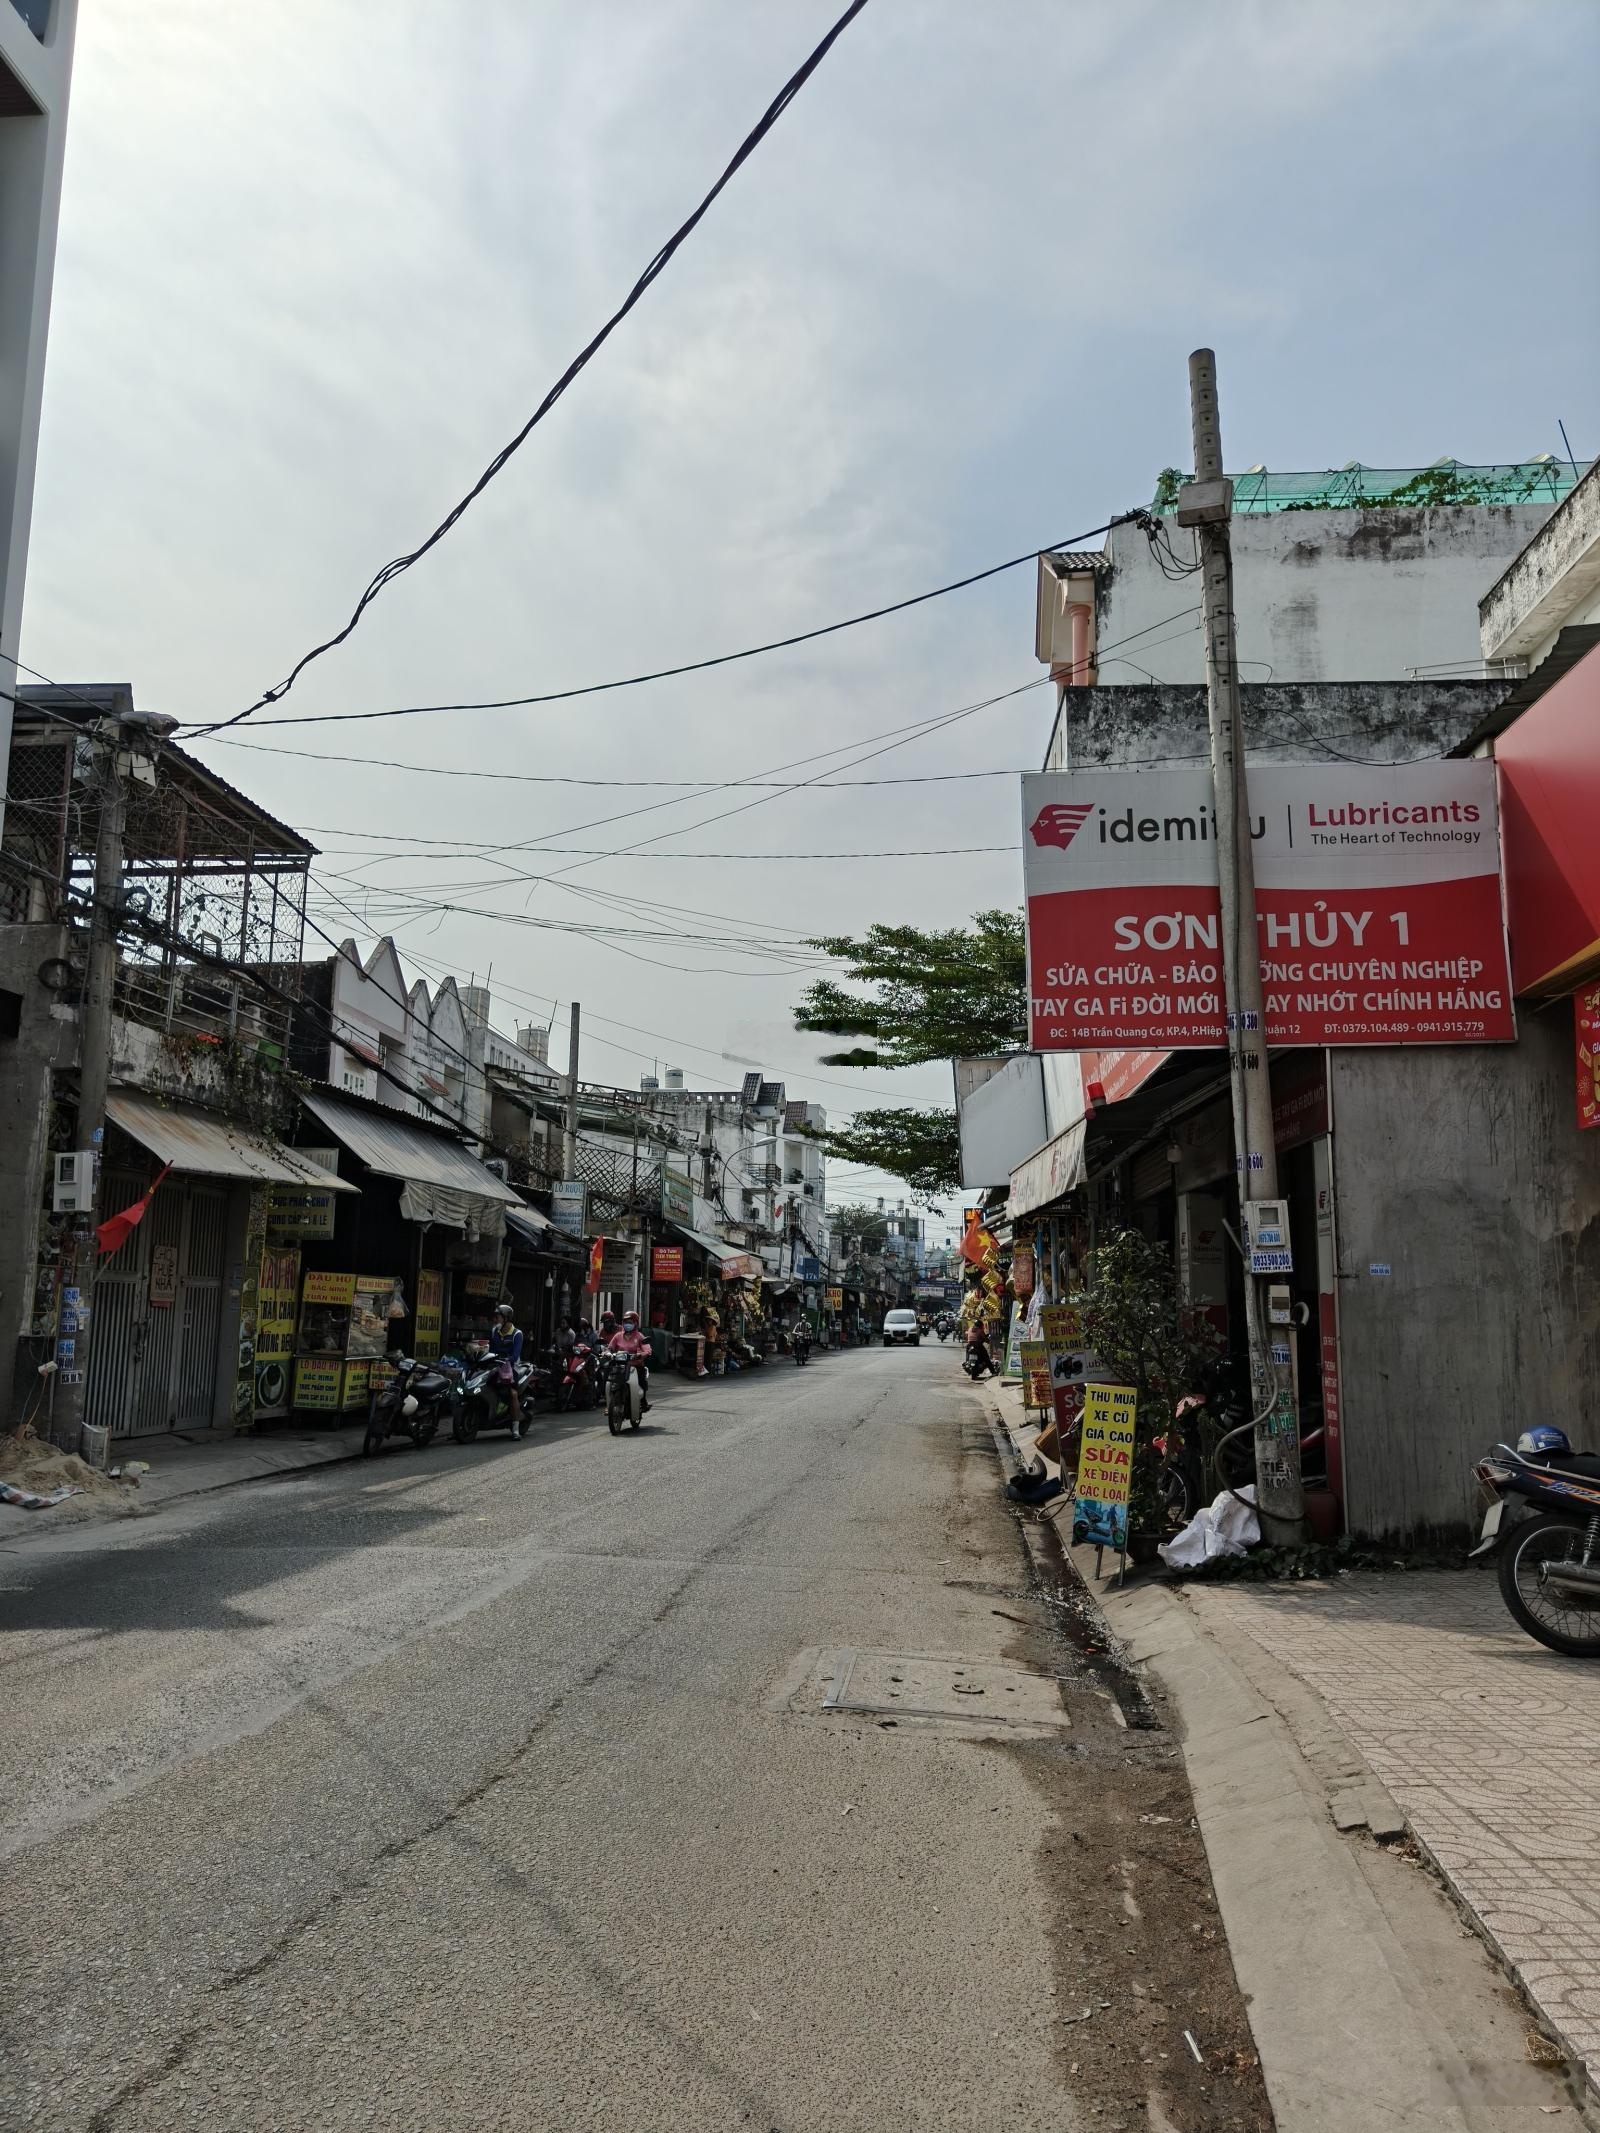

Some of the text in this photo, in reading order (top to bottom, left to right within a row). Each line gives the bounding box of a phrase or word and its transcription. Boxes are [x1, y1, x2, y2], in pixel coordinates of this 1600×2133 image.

[1308, 801, 1481, 826] Lubricants
[1099, 806, 1265, 843] idemiu
[1311, 829, 1481, 846] The Heart of Technology
[1114, 900, 1410, 951] SƠN HỦY 1
[1046, 962, 1089, 987] SỬA
[1094, 963, 1155, 986] CHỮA
[1172, 959, 1217, 984] BẢO
[1308, 957, 1397, 982] CHUYÊN
[1402, 956, 1484, 985] NGHIỆP
[1032, 998, 1069, 1018] TAY
[1074, 997, 1105, 1016] GA
[1110, 996, 1127, 1015] Fi
[1131, 992, 1172, 1015] ĐỜI
[1177, 991, 1219, 1014] MỚI
[1297, 989, 1359, 1012] NHỚT
[1362, 988, 1431, 1012] CHÍNH
[1437, 986, 1502, 1010] HÃNG
[1050, 1028, 1068, 1038] ĐC:
[1071, 1027, 1090, 1038] 14B
[1091, 1026, 1113, 1037] Trần
[1115, 1027, 1147, 1040] Quang
[1149, 1026, 1165, 1038] Cơ,
[1167, 1026, 1190, 1038] KP.4,
[1192, 1025, 1222, 1038] P.Hiệp
[1288, 1024, 1300, 1034] 12
[1324, 1023, 1341, 1034] ĐT:
[1342, 1022, 1409, 1033] 0379.104.489
[1416, 1020, 1485, 1032] 0941.915.779
[1091, 1390, 1136, 1406] THU MUA
[1094, 1410, 1129, 1424] XE CŨ
[1086, 1426, 1133, 1443] GIÁ CAO
[1085, 1444, 1130, 1466] SỬA
[1083, 1467, 1128, 1485] XE ĐIỆN
[1079, 1484, 1126, 1503] CÁC LOẠI
